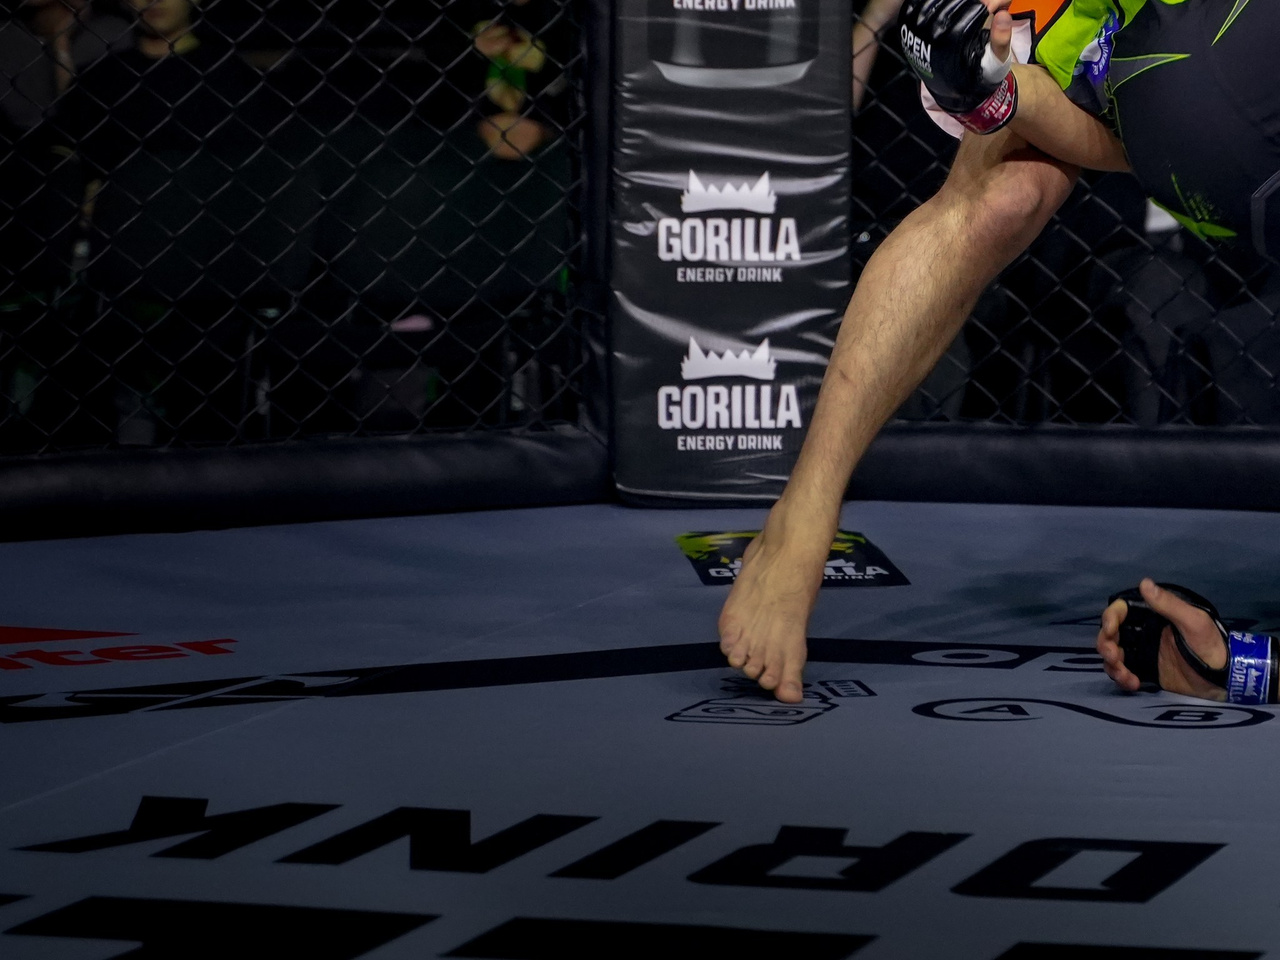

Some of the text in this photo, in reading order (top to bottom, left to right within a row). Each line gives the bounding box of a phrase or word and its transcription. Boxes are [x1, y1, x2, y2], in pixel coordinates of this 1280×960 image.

[900, 24, 932, 63] OPEN
[658, 217, 801, 262] GORILLA
[677, 268, 782, 282] ENERGY DRINK
[657, 384, 802, 430] GORILLA
[677, 435, 782, 450] ENERGY DRINK
[708, 566, 890, 577] GLLA
[0, 638, 238, 670] ter
[12, 796, 1227, 903] DRINK
